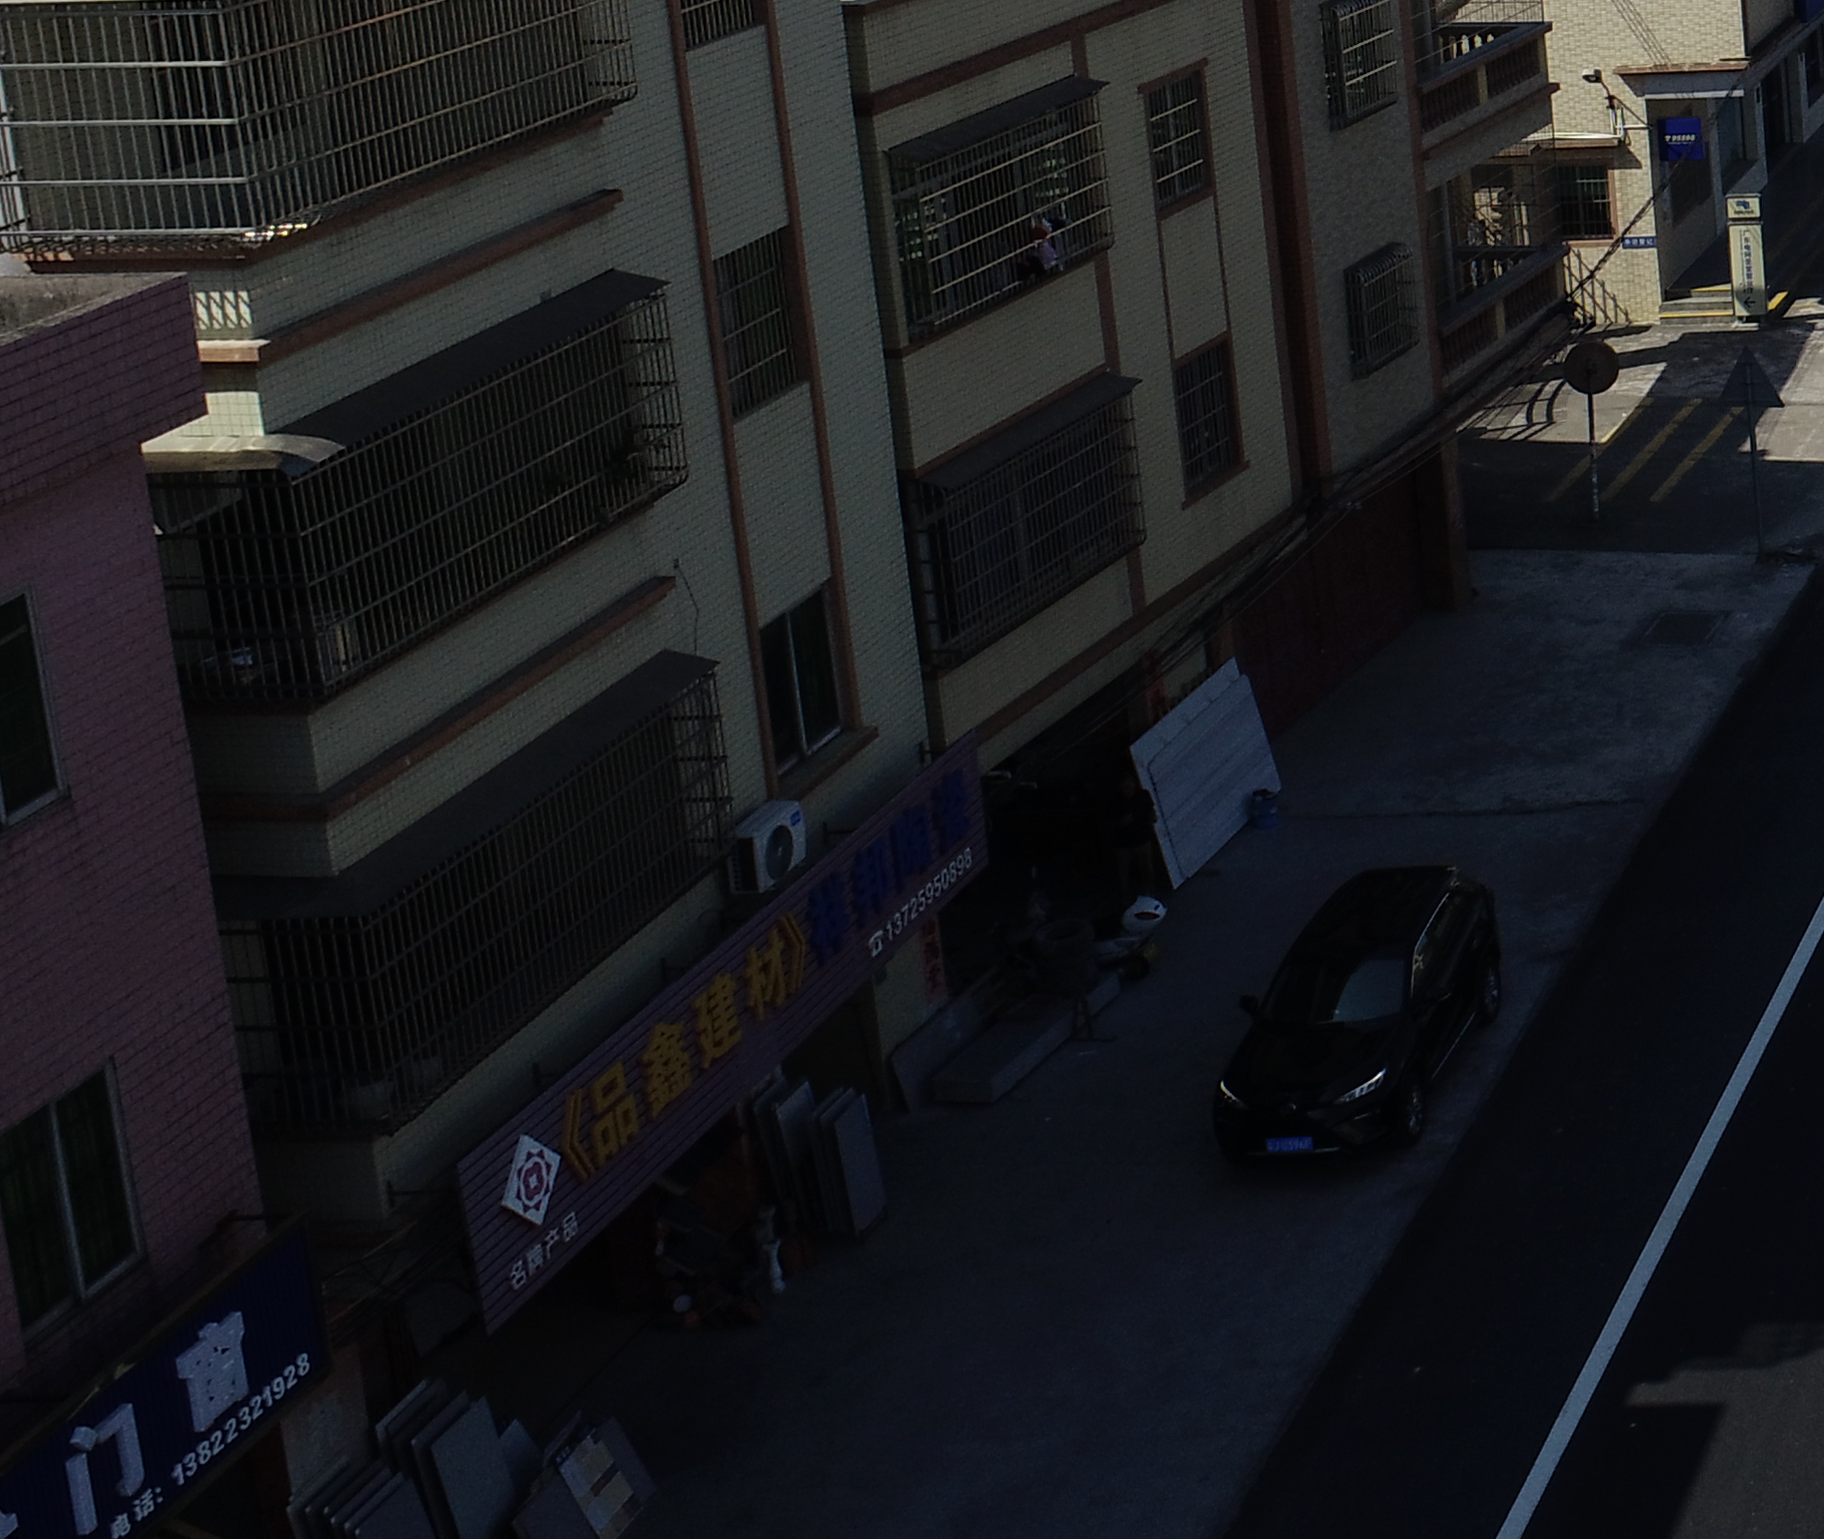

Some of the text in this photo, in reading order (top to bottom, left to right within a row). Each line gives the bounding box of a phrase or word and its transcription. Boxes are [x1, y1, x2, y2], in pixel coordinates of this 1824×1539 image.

[510, 1212, 580, 1290] 名牌产品
[0, 1310, 250, 1538] 门窗
[170, 1351, 311, 1486] 13822321928
